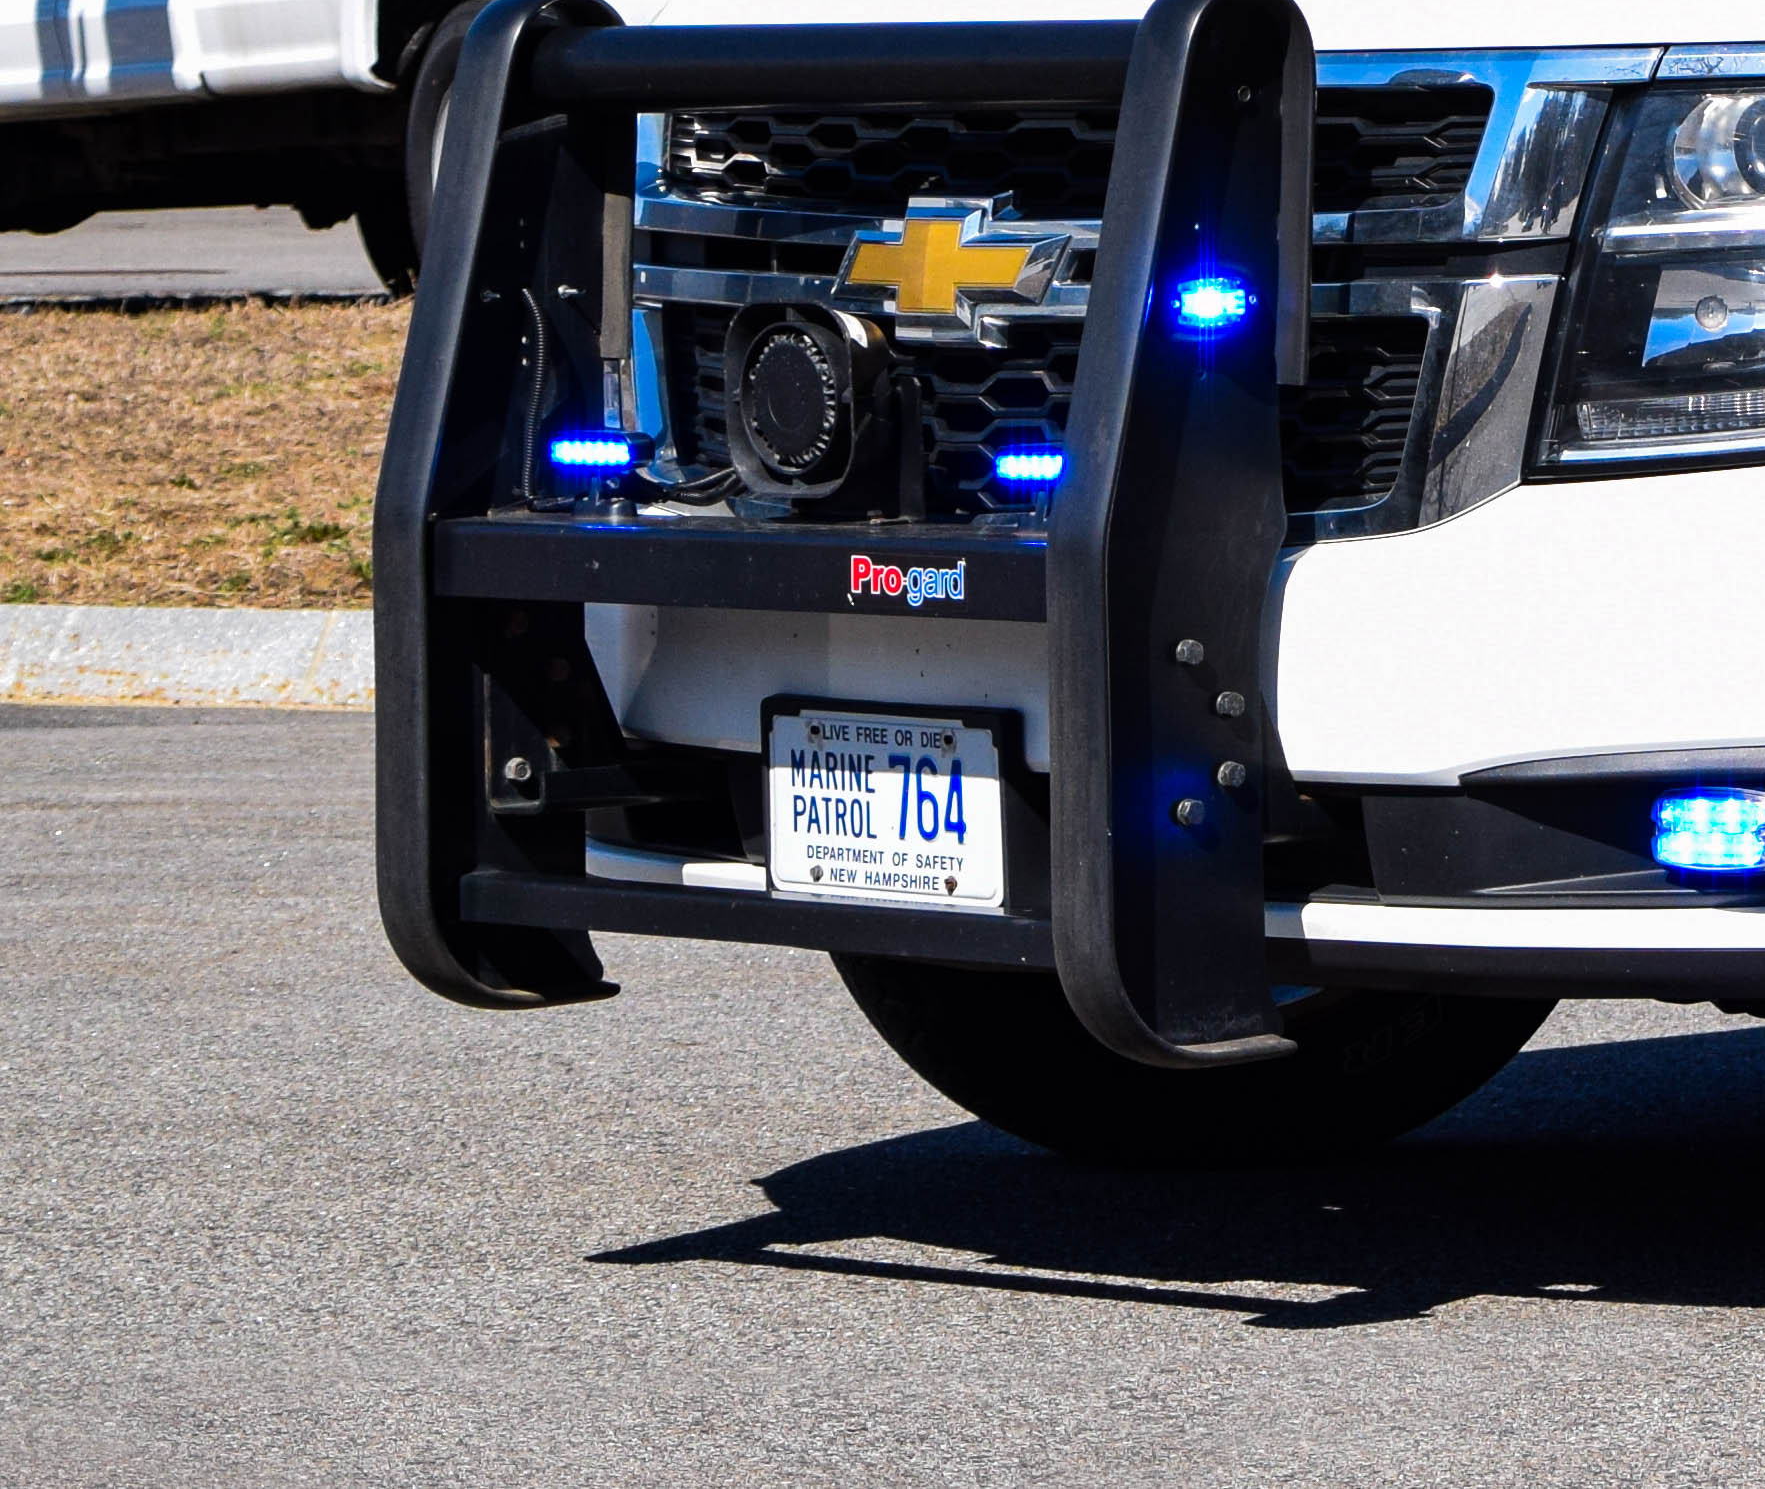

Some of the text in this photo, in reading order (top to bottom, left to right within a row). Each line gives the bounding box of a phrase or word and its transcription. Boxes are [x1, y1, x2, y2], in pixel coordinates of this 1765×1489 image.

[822, 724, 942, 749] LIVE FREE OR DIE
[790, 748, 876, 794] MARINE
[792, 794, 878, 839] PATROL
[888, 752, 967, 845] 764
[807, 844, 964, 872] DEPARTMENT OF SAFETY
[830, 867, 940, 891] NEW HAMPSHIRE
